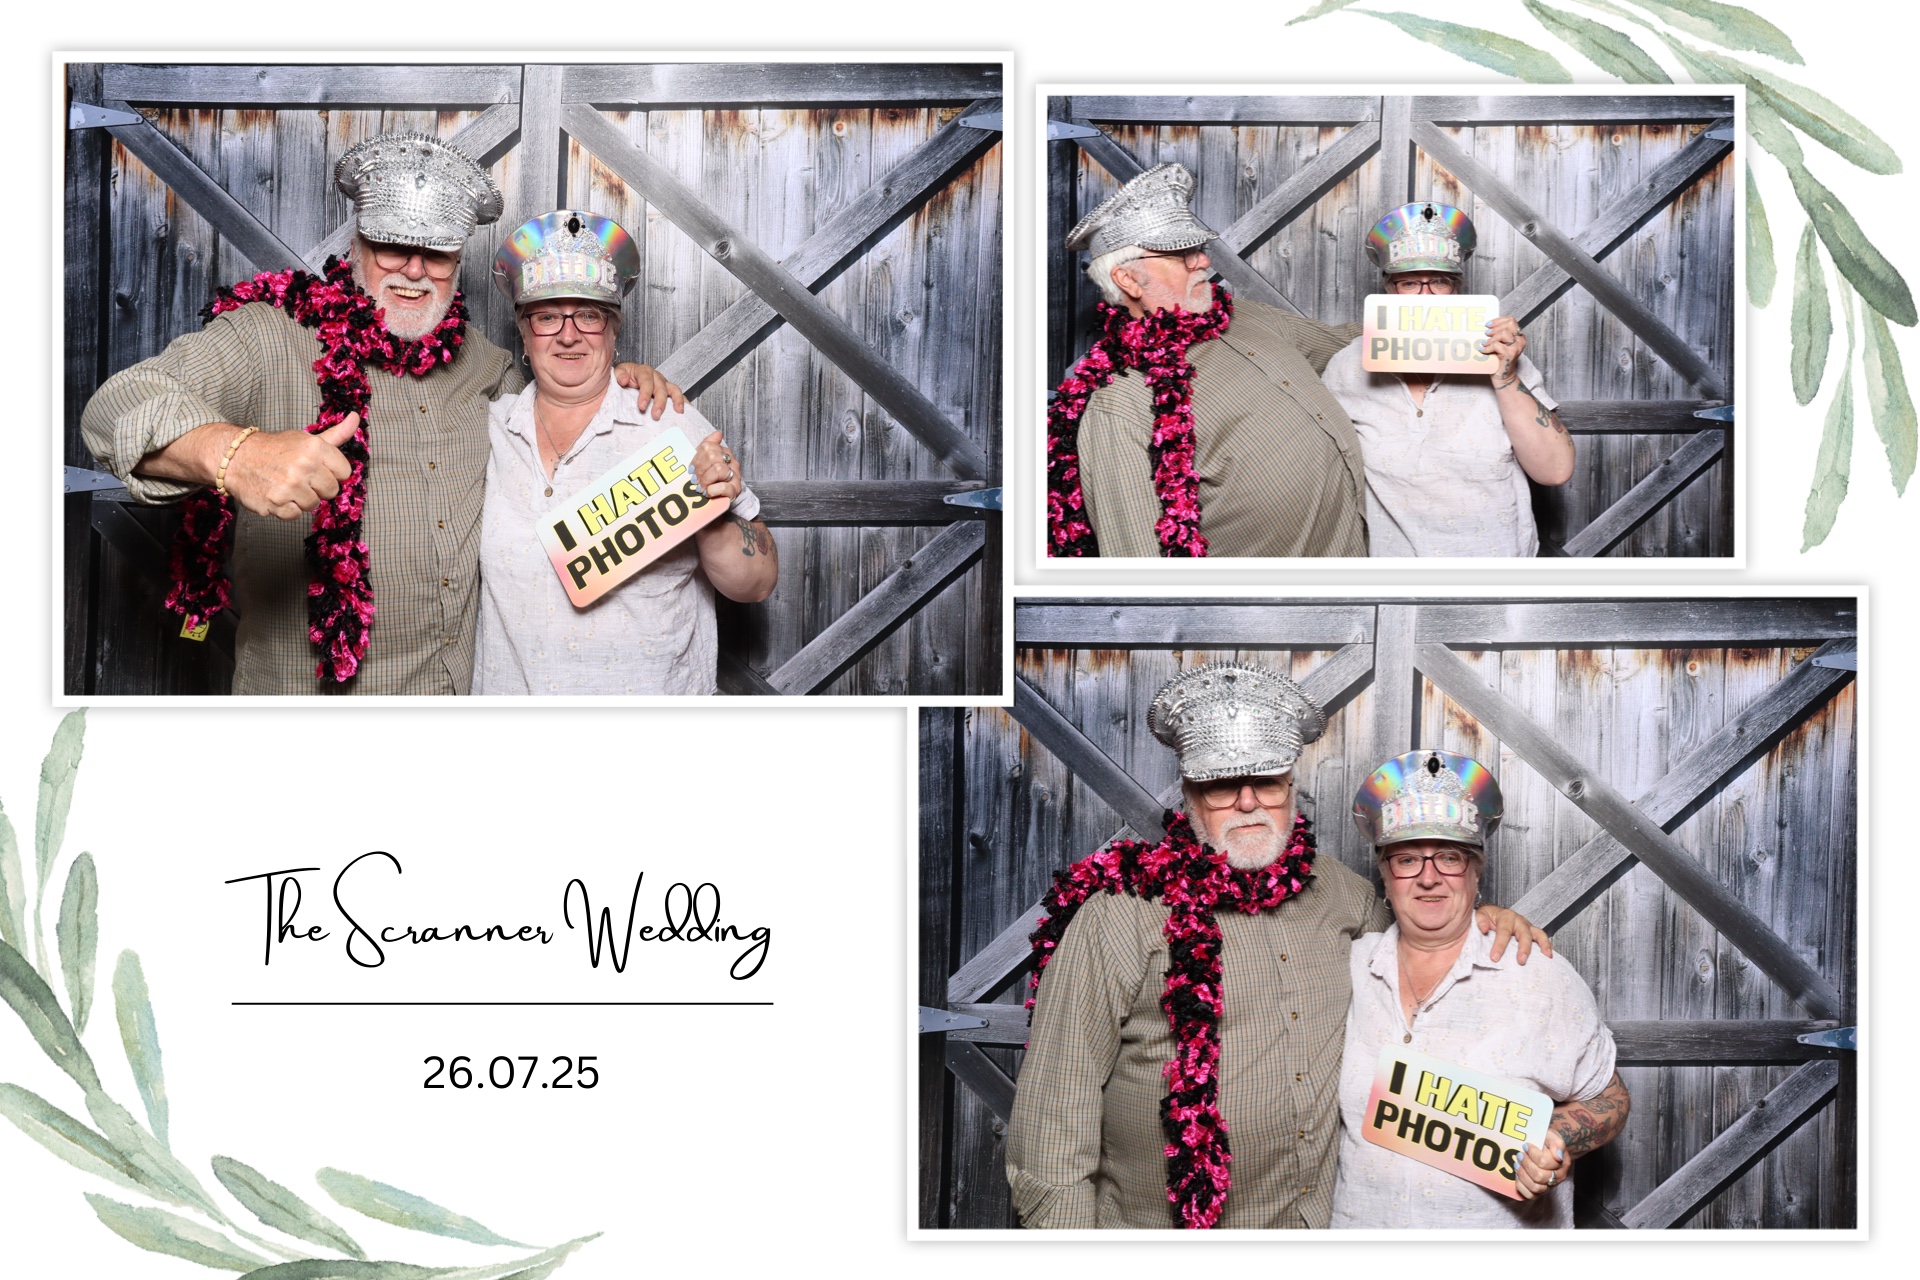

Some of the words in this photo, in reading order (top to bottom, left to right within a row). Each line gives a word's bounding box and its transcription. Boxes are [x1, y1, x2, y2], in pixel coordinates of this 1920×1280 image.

[1389, 236, 1461, 263] BRIDE
[522, 254, 617, 292] BRIDE
[1377, 305, 1387, 330] I
[1399, 305, 1486, 332] HATE
[553, 520, 578, 552] I
[577, 445, 687, 537] HATE
[1381, 793, 1479, 833] BRIDE
[1389, 1060, 1407, 1095] I
[1415, 1070, 1533, 1141] HATE
